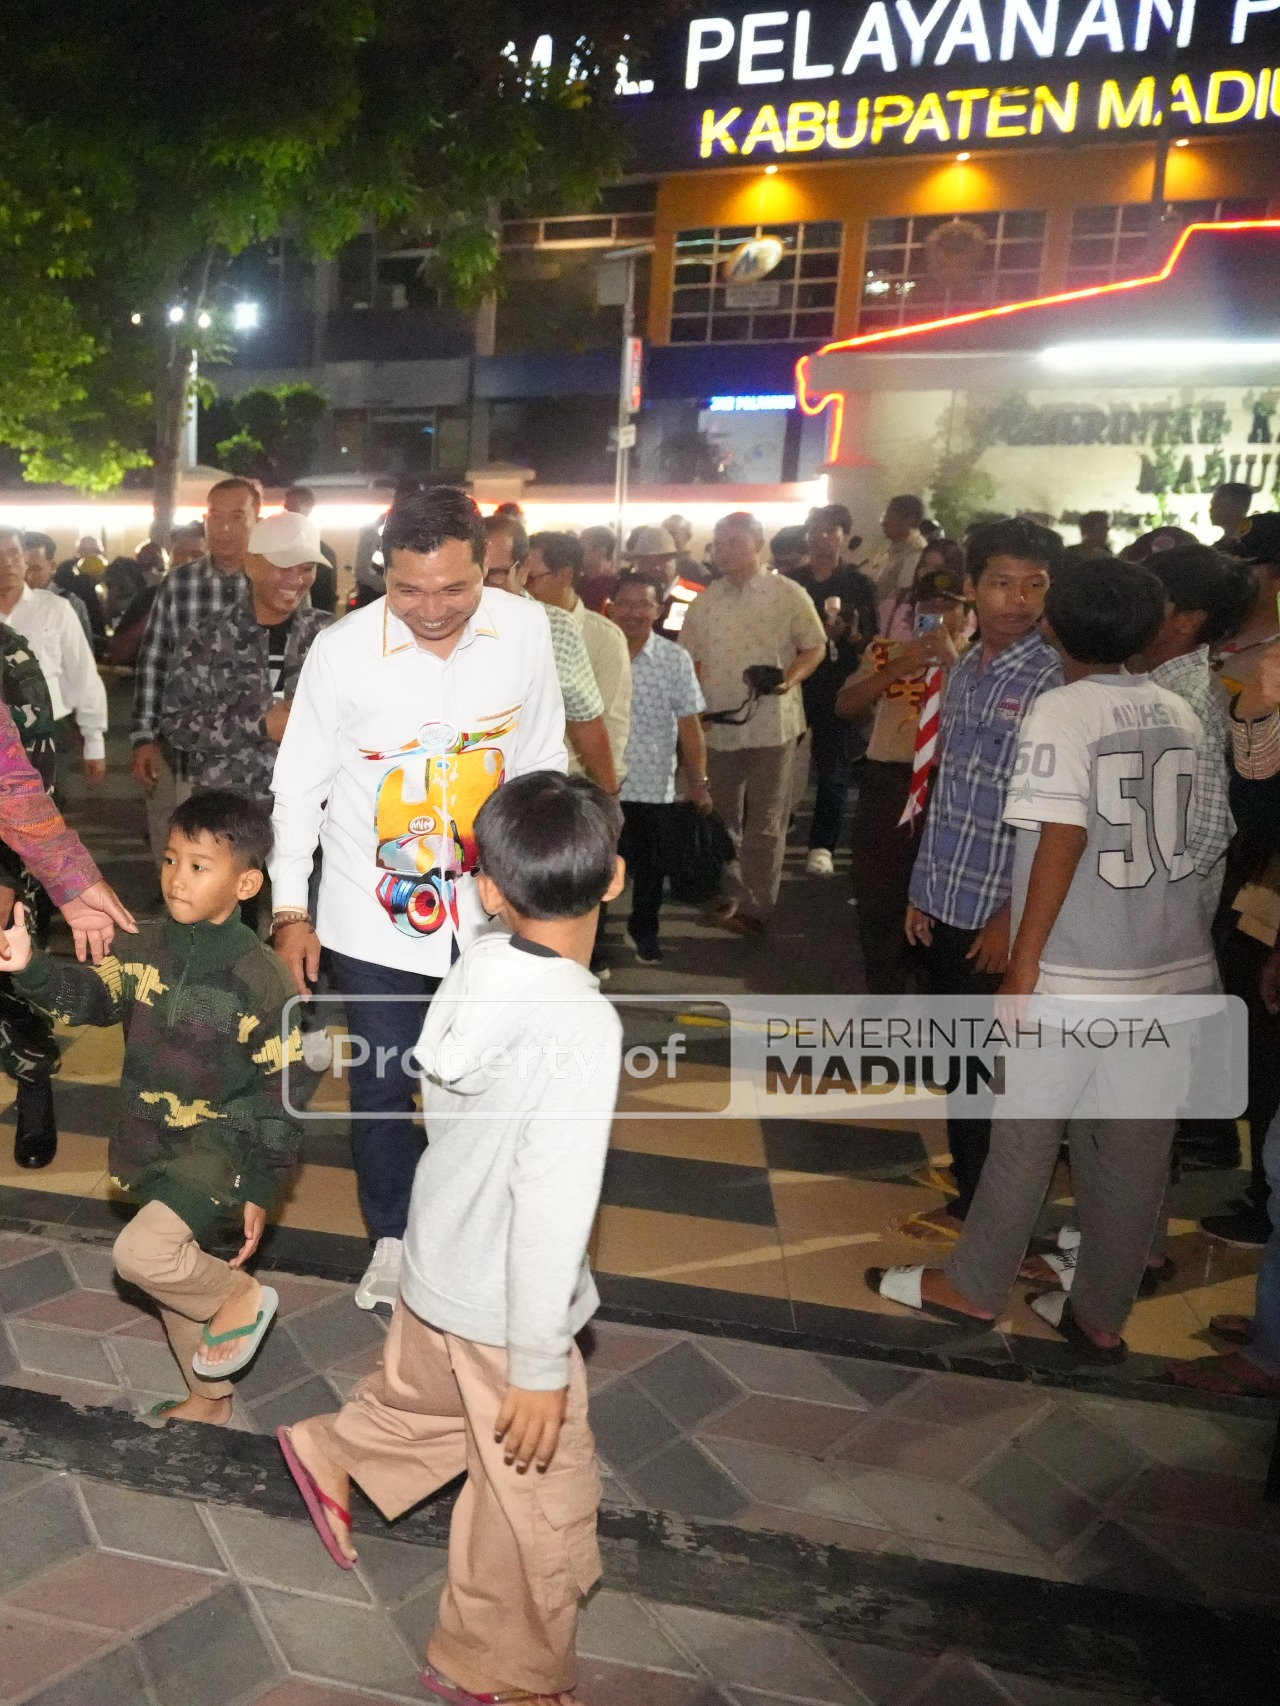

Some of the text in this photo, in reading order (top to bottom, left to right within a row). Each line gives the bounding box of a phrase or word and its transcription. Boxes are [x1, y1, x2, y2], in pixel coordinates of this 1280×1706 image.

[685, 0, 1196, 90] PELAYANAN
[699, 67, 1280, 158] KABUPATEN MADI
[1096, 747, 1198, 890] 50
